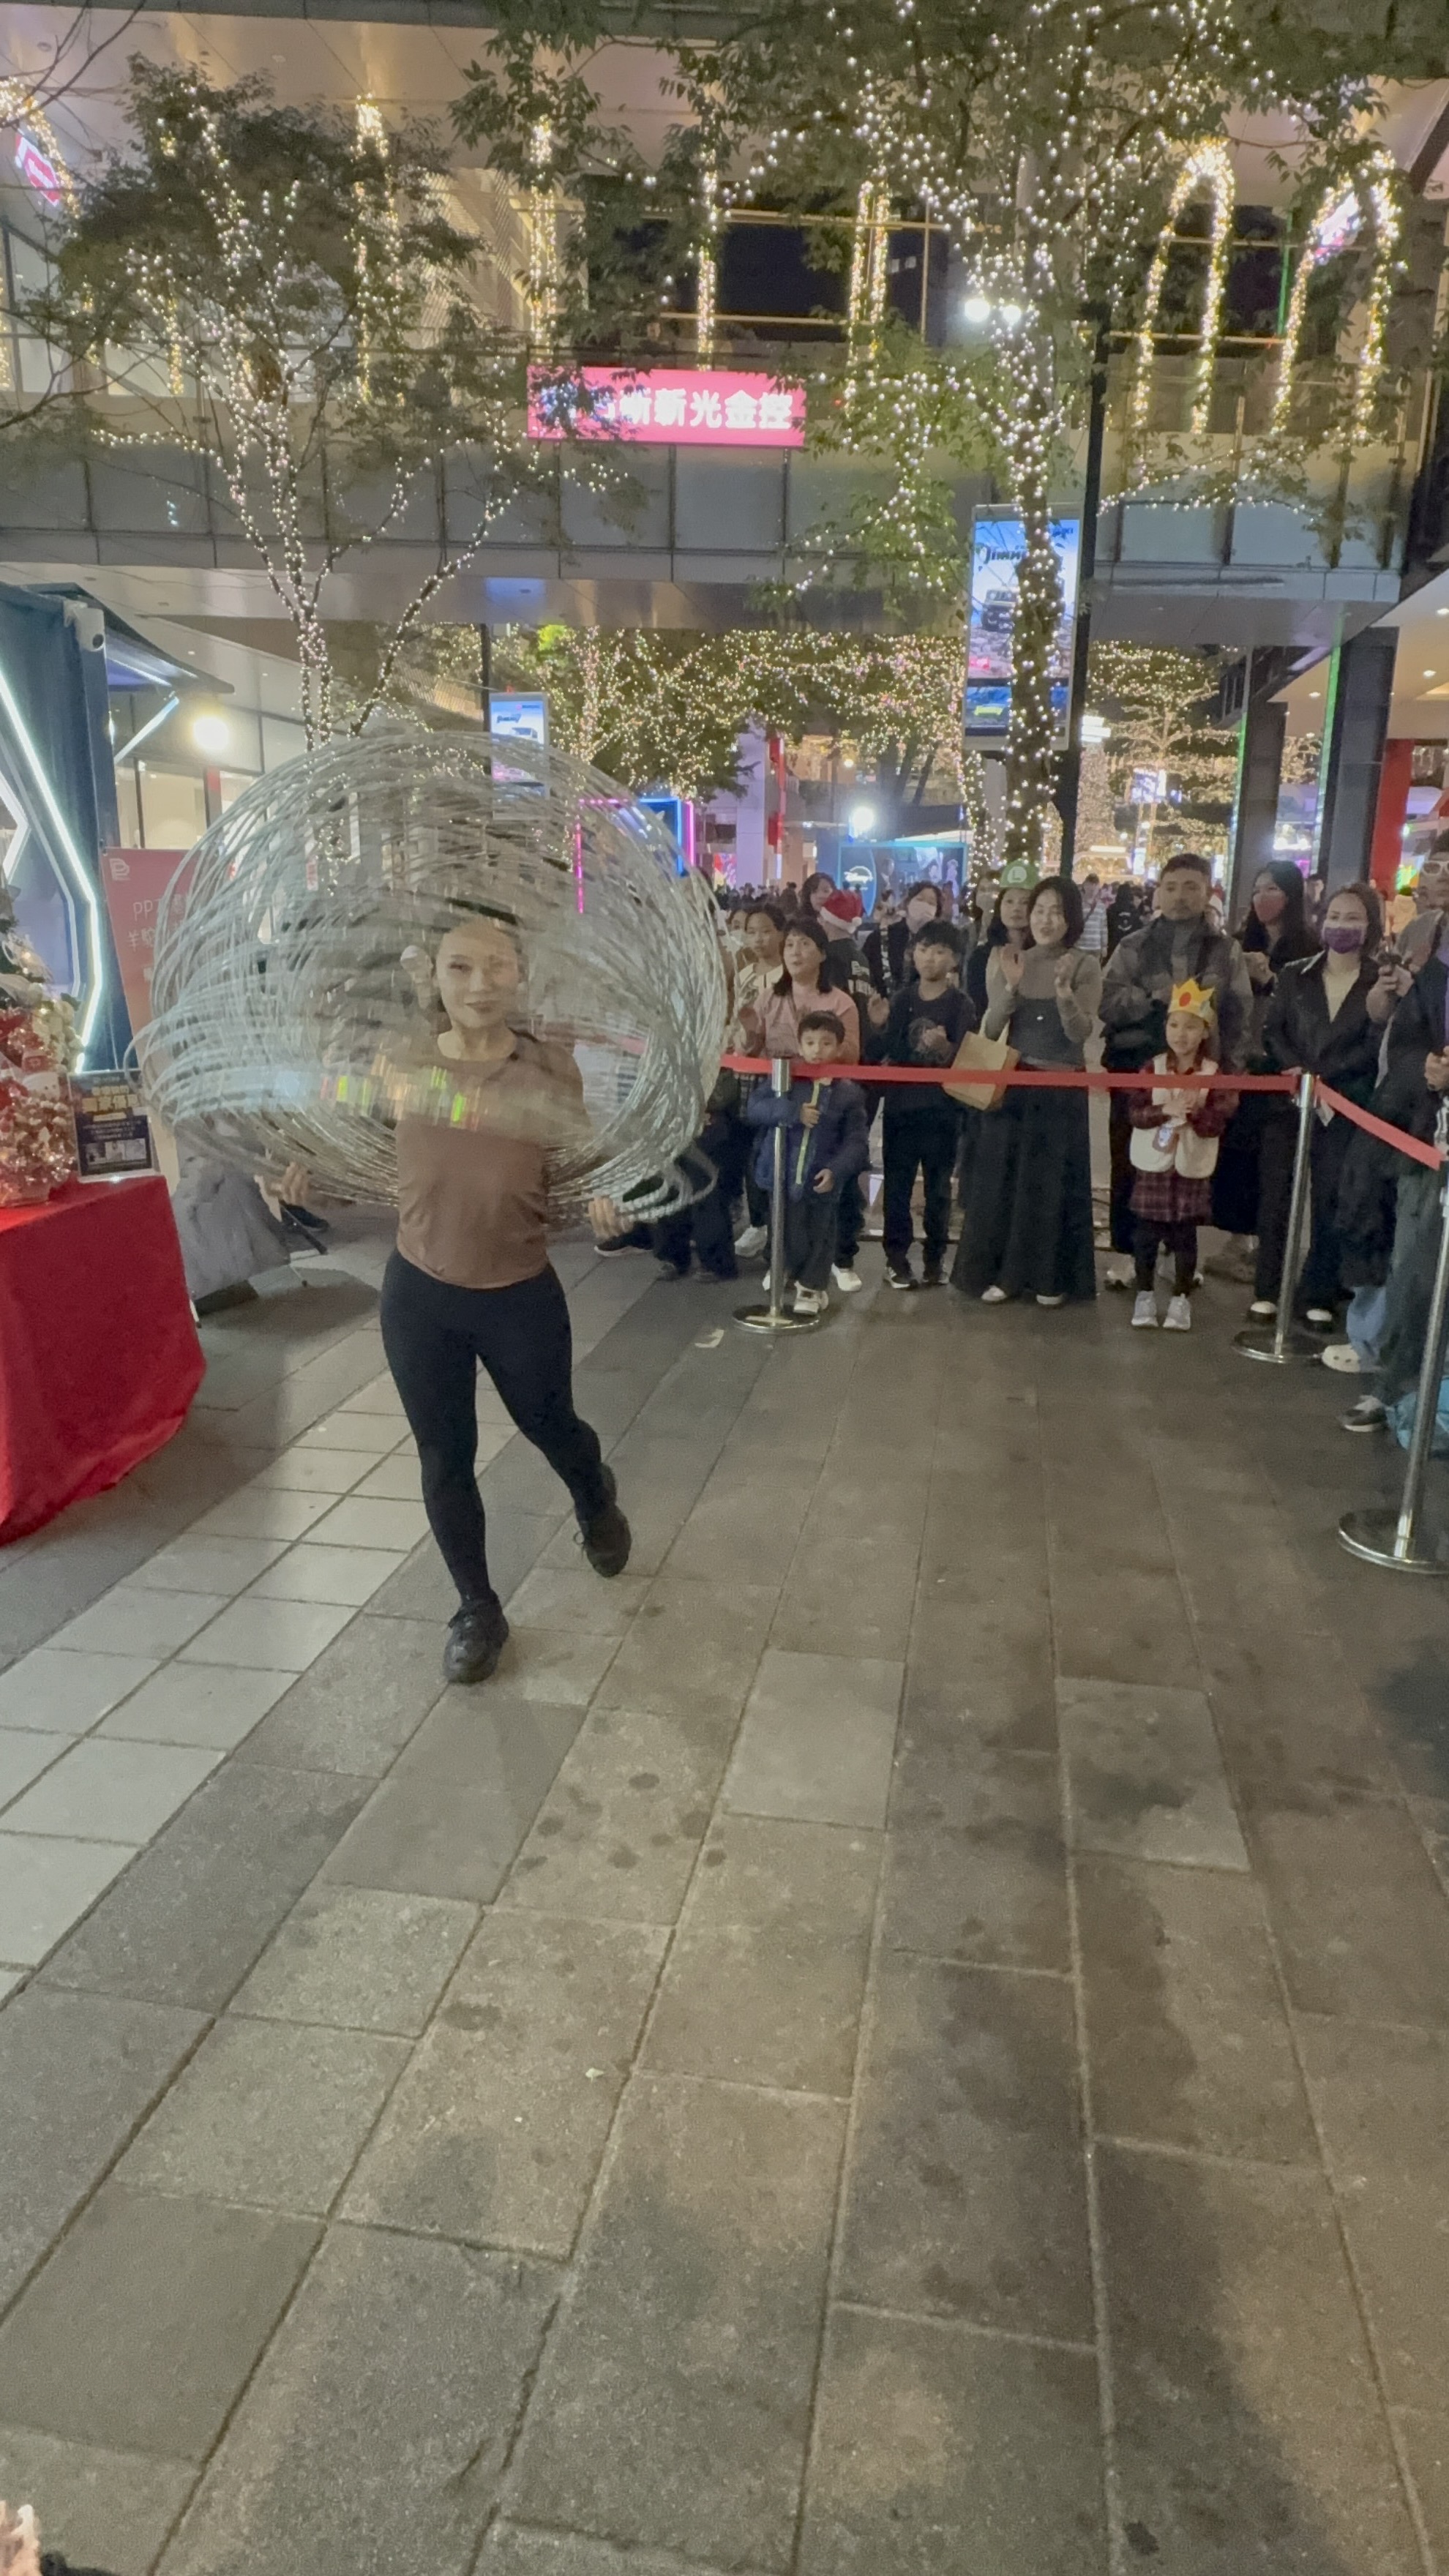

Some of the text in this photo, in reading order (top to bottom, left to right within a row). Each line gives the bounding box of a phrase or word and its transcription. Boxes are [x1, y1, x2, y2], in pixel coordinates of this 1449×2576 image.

[591, 386, 794, 430] 新新光金控
